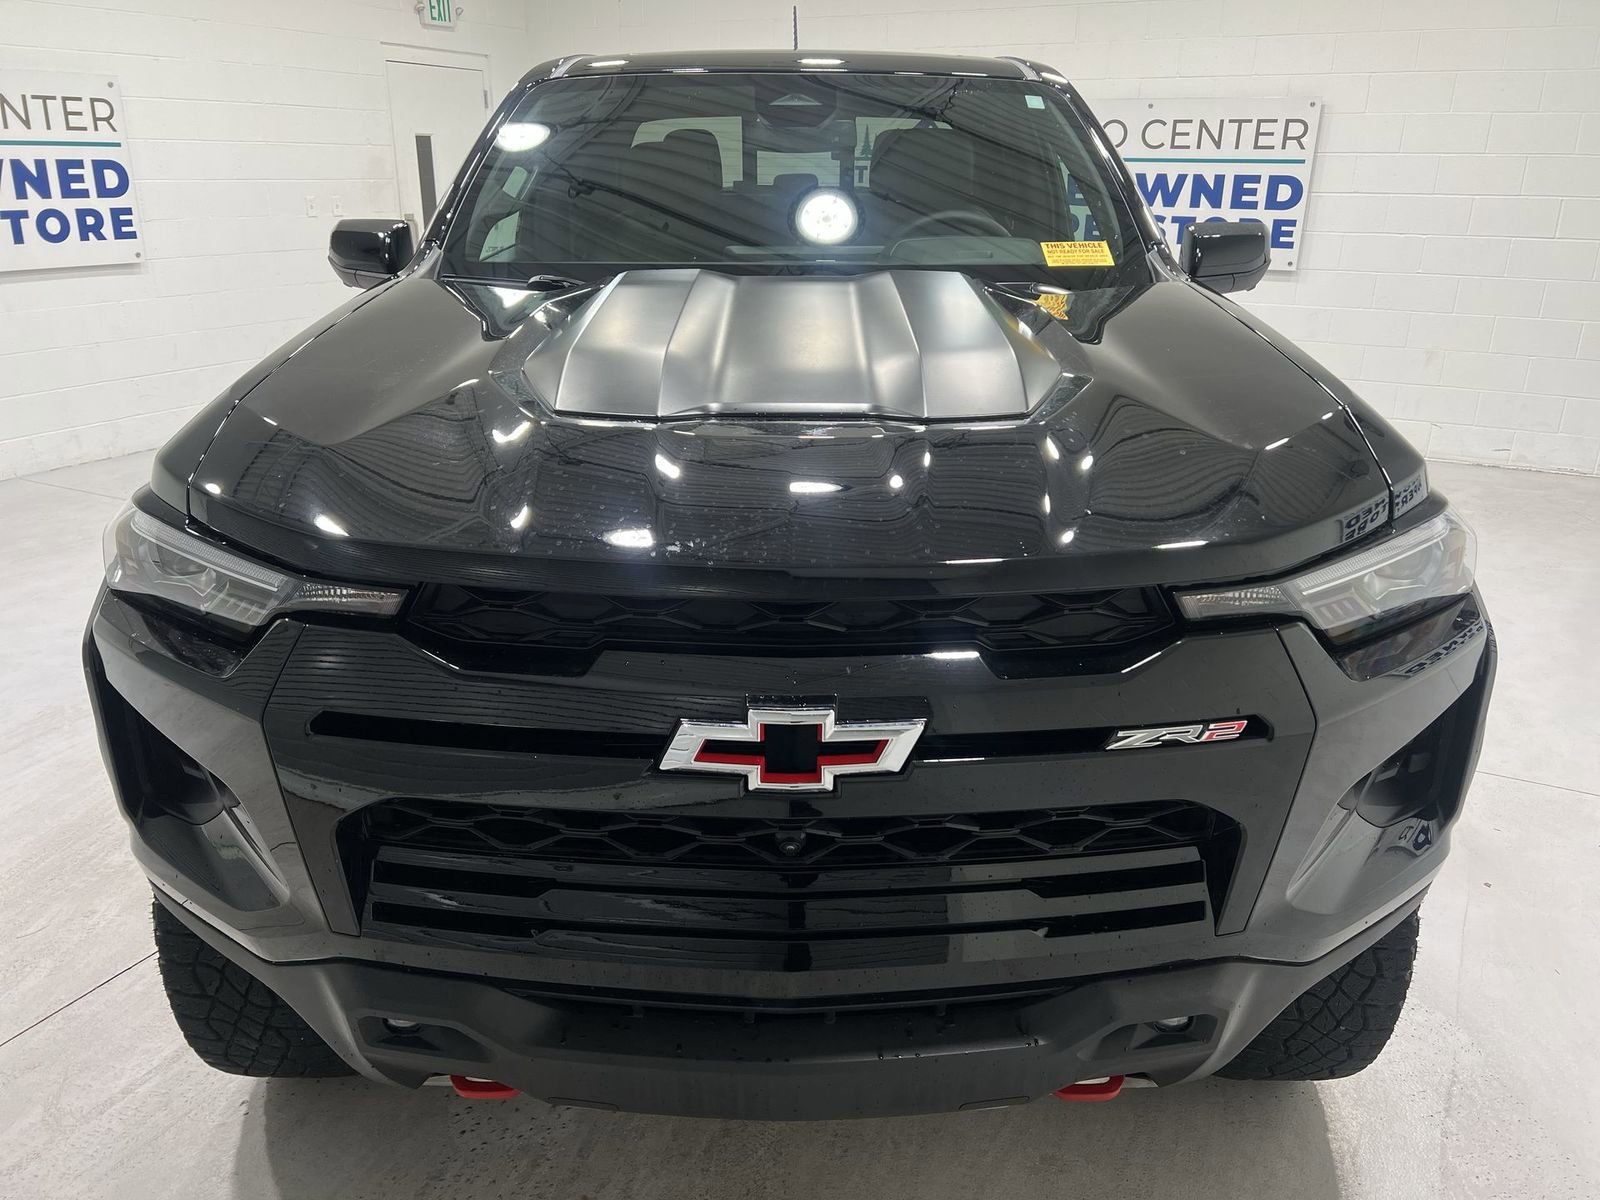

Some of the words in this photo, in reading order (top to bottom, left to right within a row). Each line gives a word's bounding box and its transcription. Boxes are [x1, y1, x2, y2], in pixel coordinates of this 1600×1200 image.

[1141, 118, 1309, 150] CENTER
[0, 158, 130, 200] NED
[1105, 720, 1248, 750] ZR2
